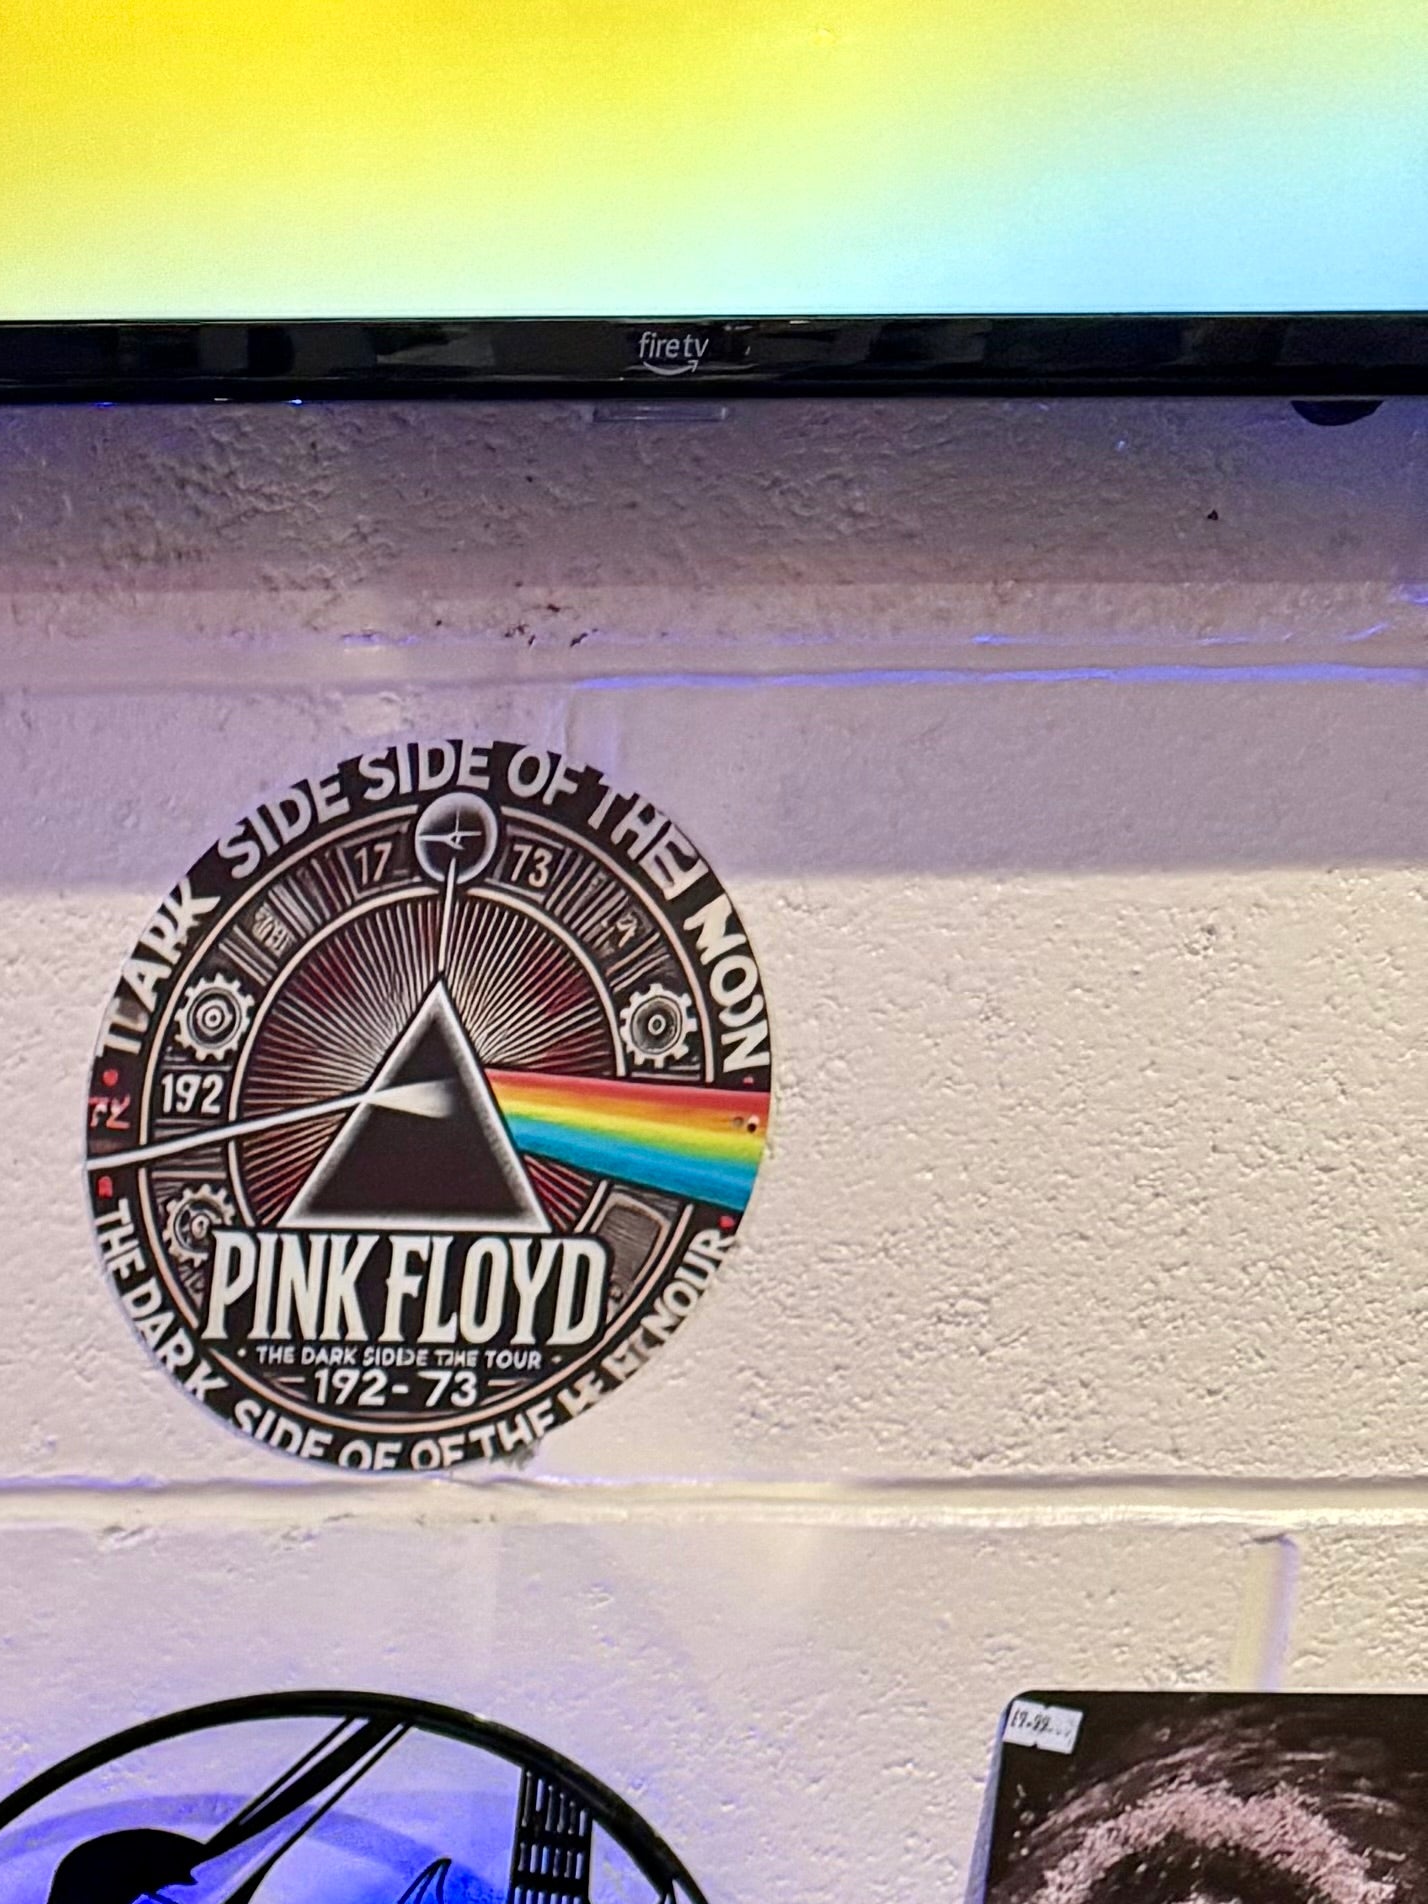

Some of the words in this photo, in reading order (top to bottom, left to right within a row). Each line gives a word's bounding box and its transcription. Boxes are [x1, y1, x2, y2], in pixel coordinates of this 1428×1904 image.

[217, 772, 351, 880] SIDE
[358, 740, 492, 800] SIDE
[507, 745, 587, 805] OF
[161, 1073, 224, 1115] 192
[94, 1199, 146, 1281] THE
[122, 1278, 230, 1401] DARK
[201, 1231, 380, 1341] PINK
[379, 1233, 608, 1346] FLOYD
[256, 1345, 295, 1365] THE
[301, 1346, 356, 1366] DARK
[484, 1350, 542, 1370] TOUR
